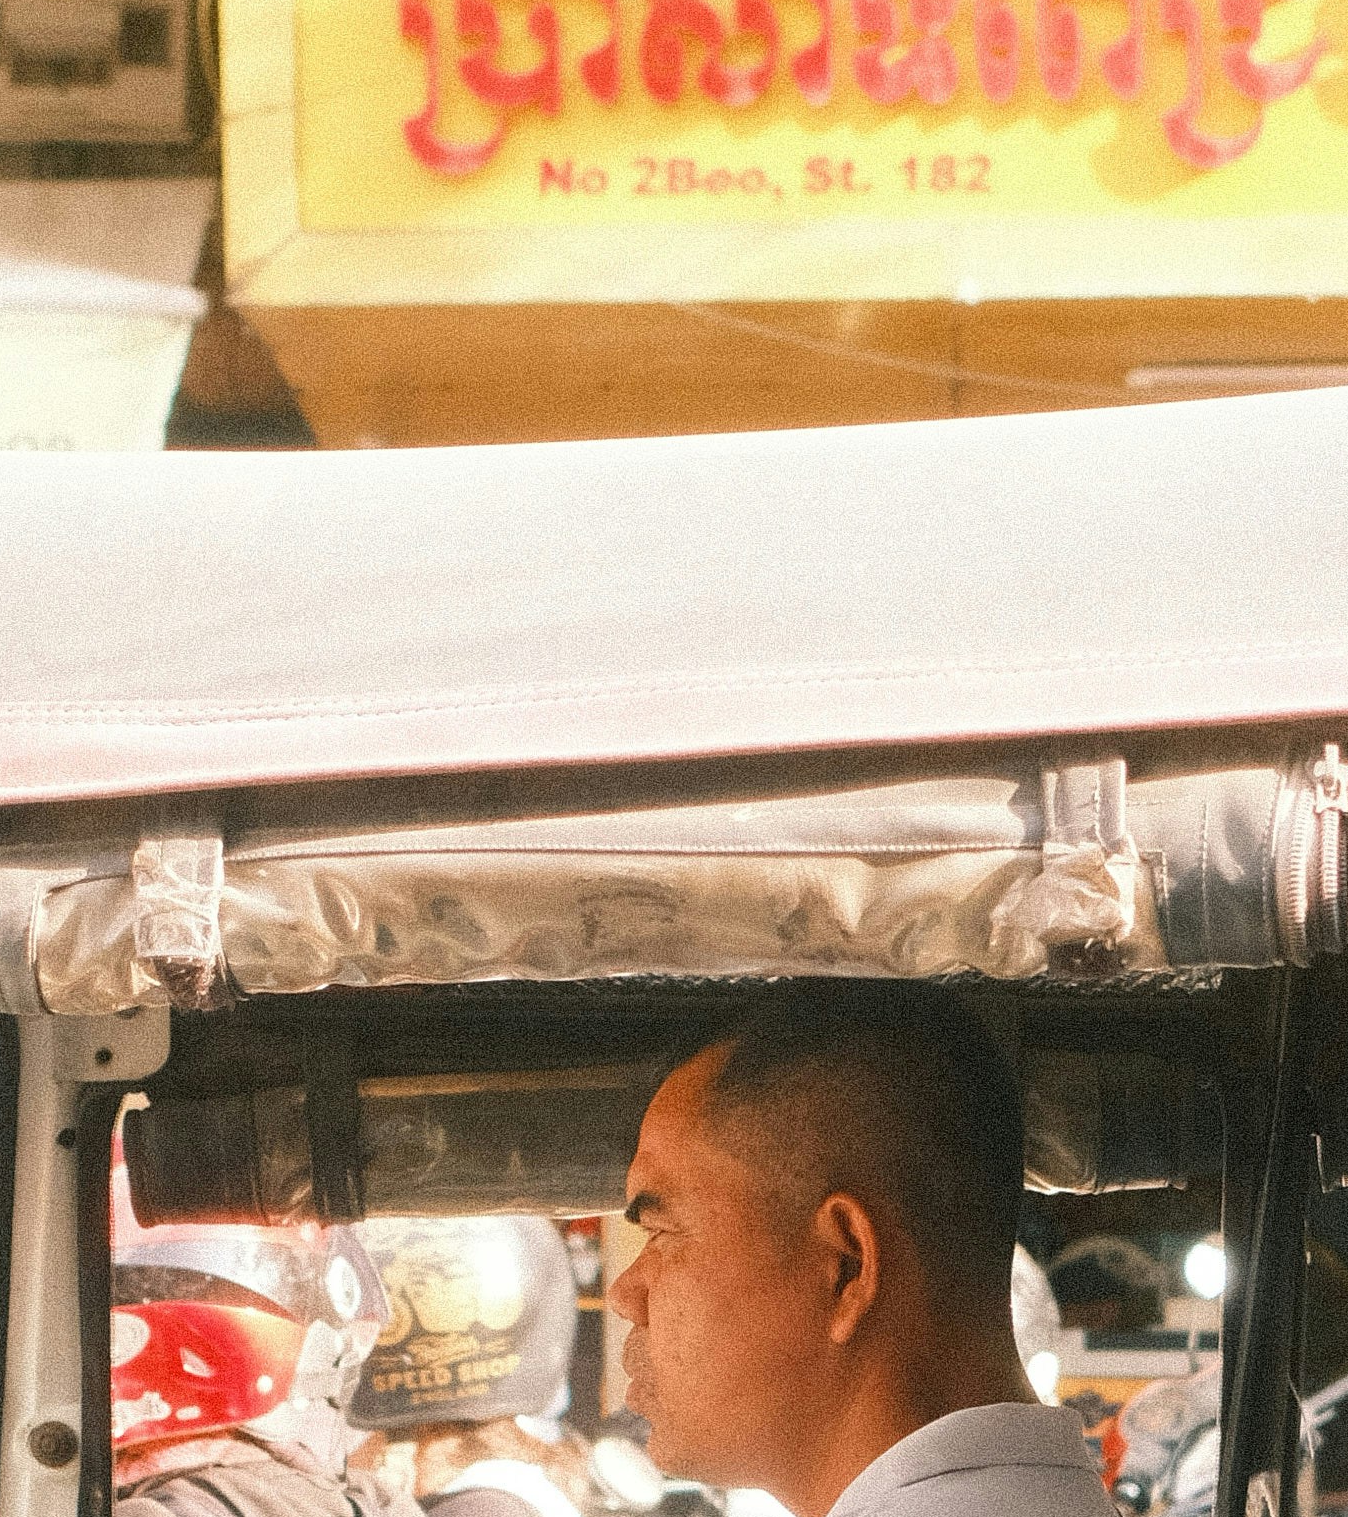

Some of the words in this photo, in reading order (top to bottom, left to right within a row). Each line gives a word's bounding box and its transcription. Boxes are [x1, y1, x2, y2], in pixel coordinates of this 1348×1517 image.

[539, 155, 609, 195] No
[803, 154, 873, 194] St.
[900, 153, 993, 194] 182
[372, 1366, 451, 1393] SPEED
